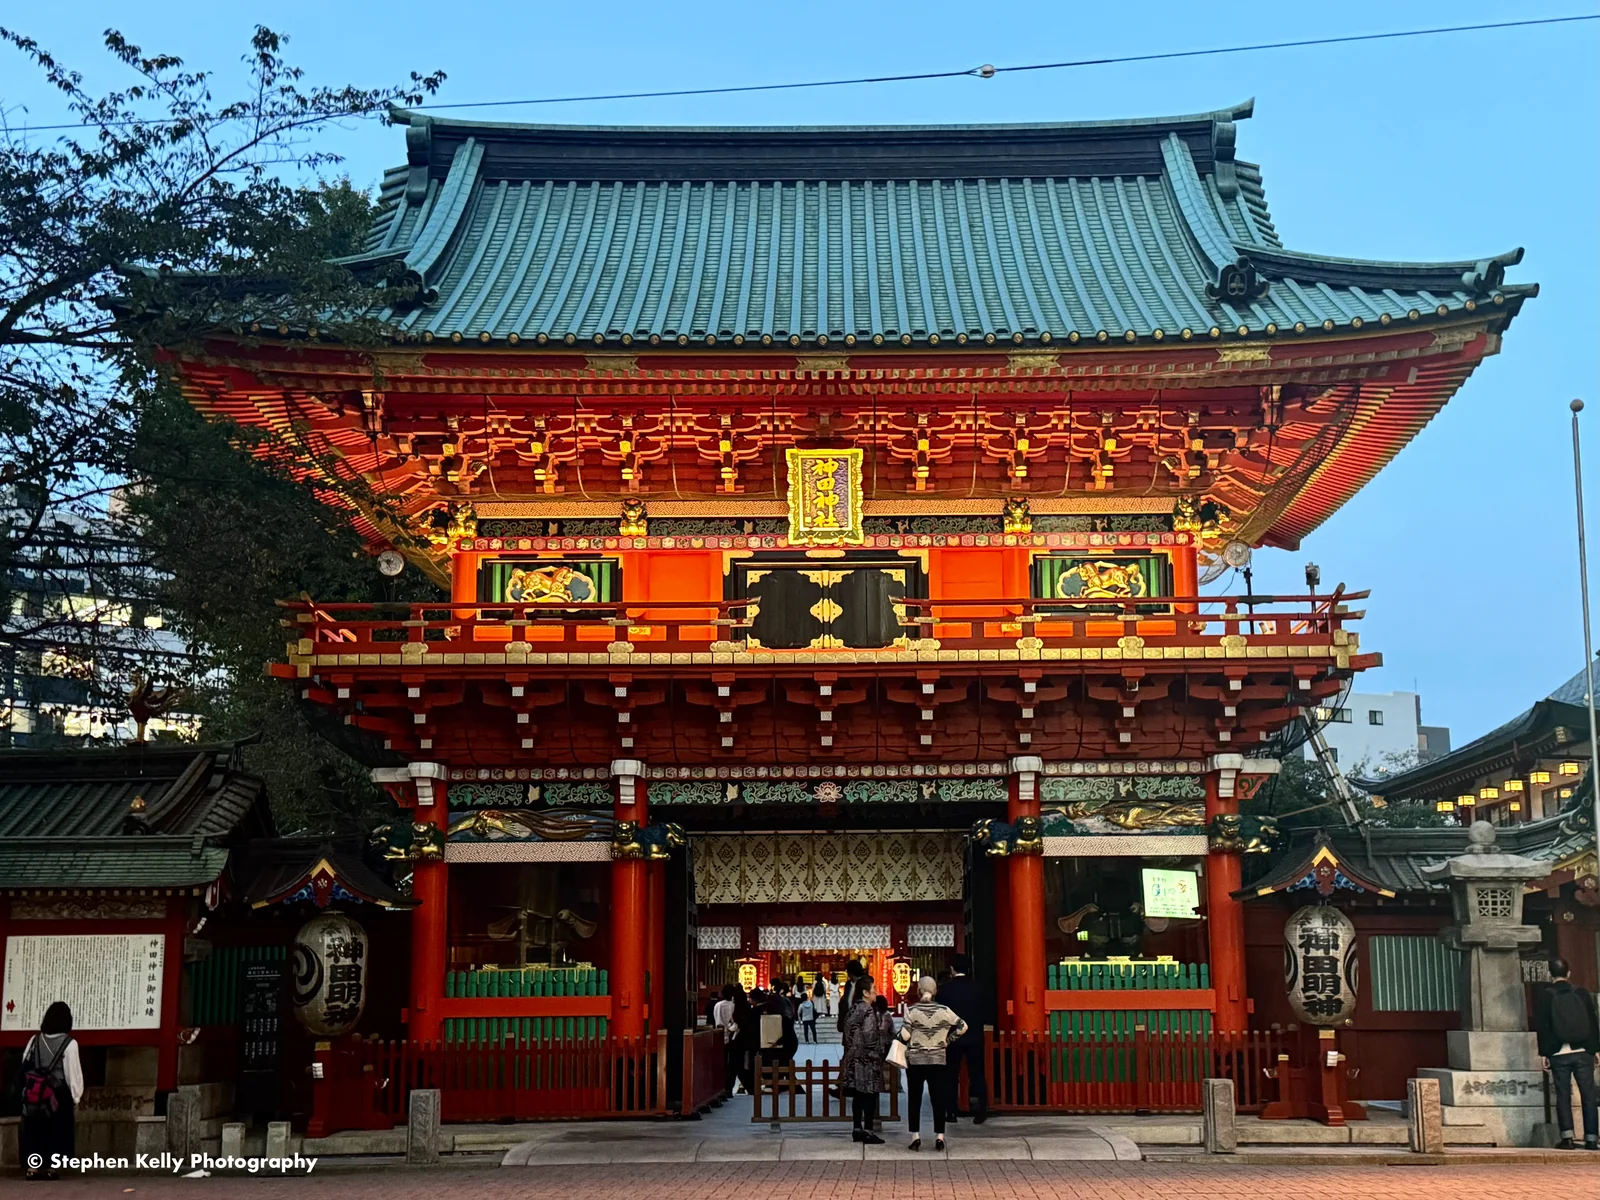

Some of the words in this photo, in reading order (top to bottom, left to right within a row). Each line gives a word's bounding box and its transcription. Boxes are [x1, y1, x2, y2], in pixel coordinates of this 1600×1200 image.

[811, 458, 840, 527] 神田神社
[145, 939, 160, 1017] 神田神社御由緒
[324, 937, 364, 1026] 神田明神
[1297, 927, 1345, 1017] 神田明神
